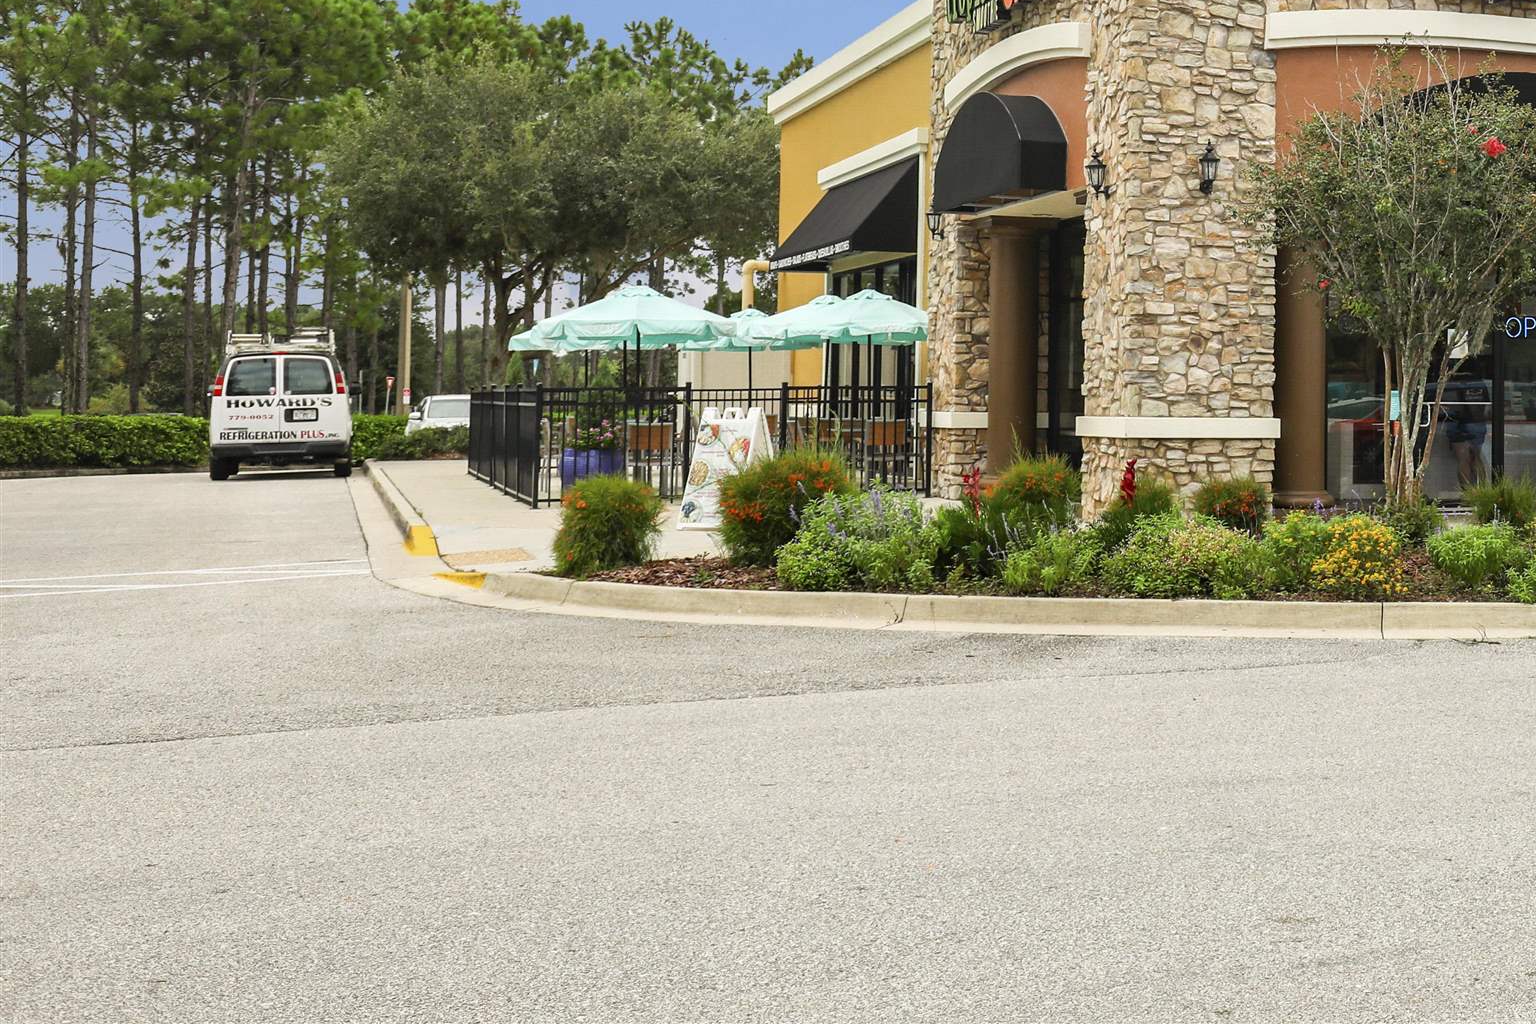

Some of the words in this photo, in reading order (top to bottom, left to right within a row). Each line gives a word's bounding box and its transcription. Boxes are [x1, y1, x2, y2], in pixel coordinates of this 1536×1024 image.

[226, 397, 333, 408] HOWARD'S
[219, 430, 297, 441] REFRIGERATION
[300, 430, 325, 439] PLUS
